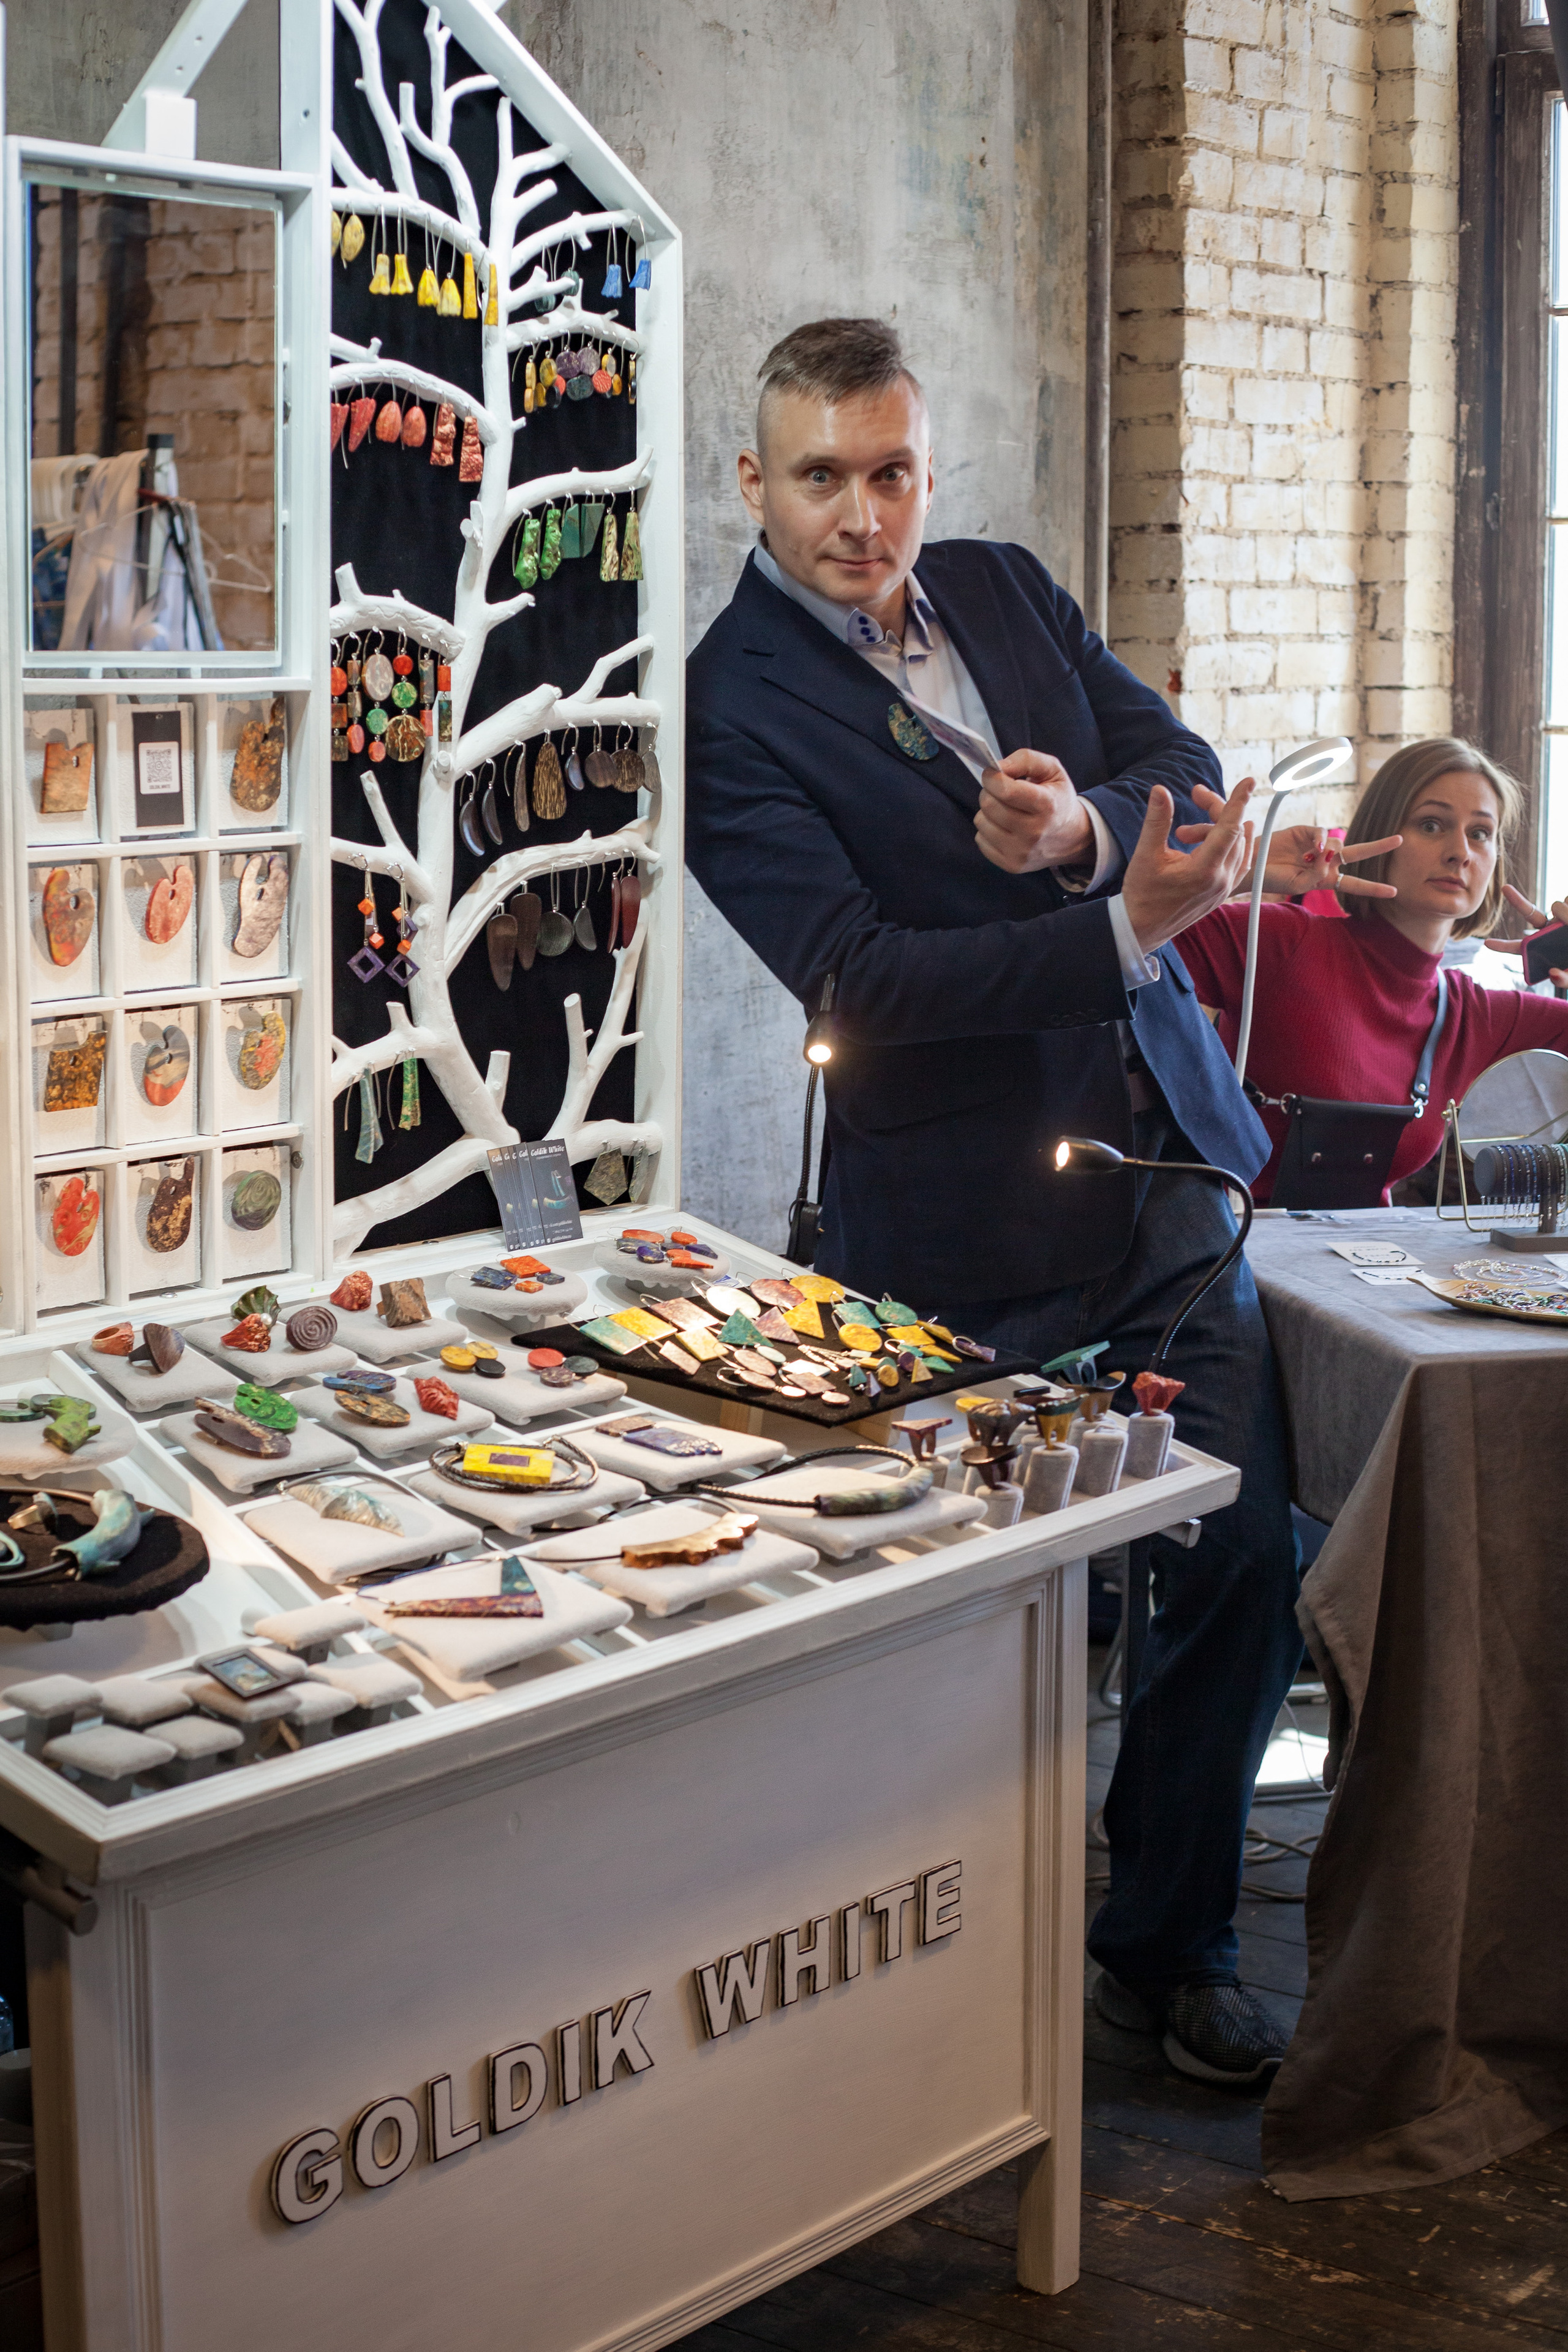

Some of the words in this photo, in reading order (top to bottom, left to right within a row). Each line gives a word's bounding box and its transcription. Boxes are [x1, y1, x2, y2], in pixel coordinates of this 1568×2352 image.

[530, 1147, 547, 1156] Goldik
[548, 1145, 565, 1154] White
[270, 1989, 654, 2224] GOLDIK
[695, 1858, 962, 2039] WHITE
